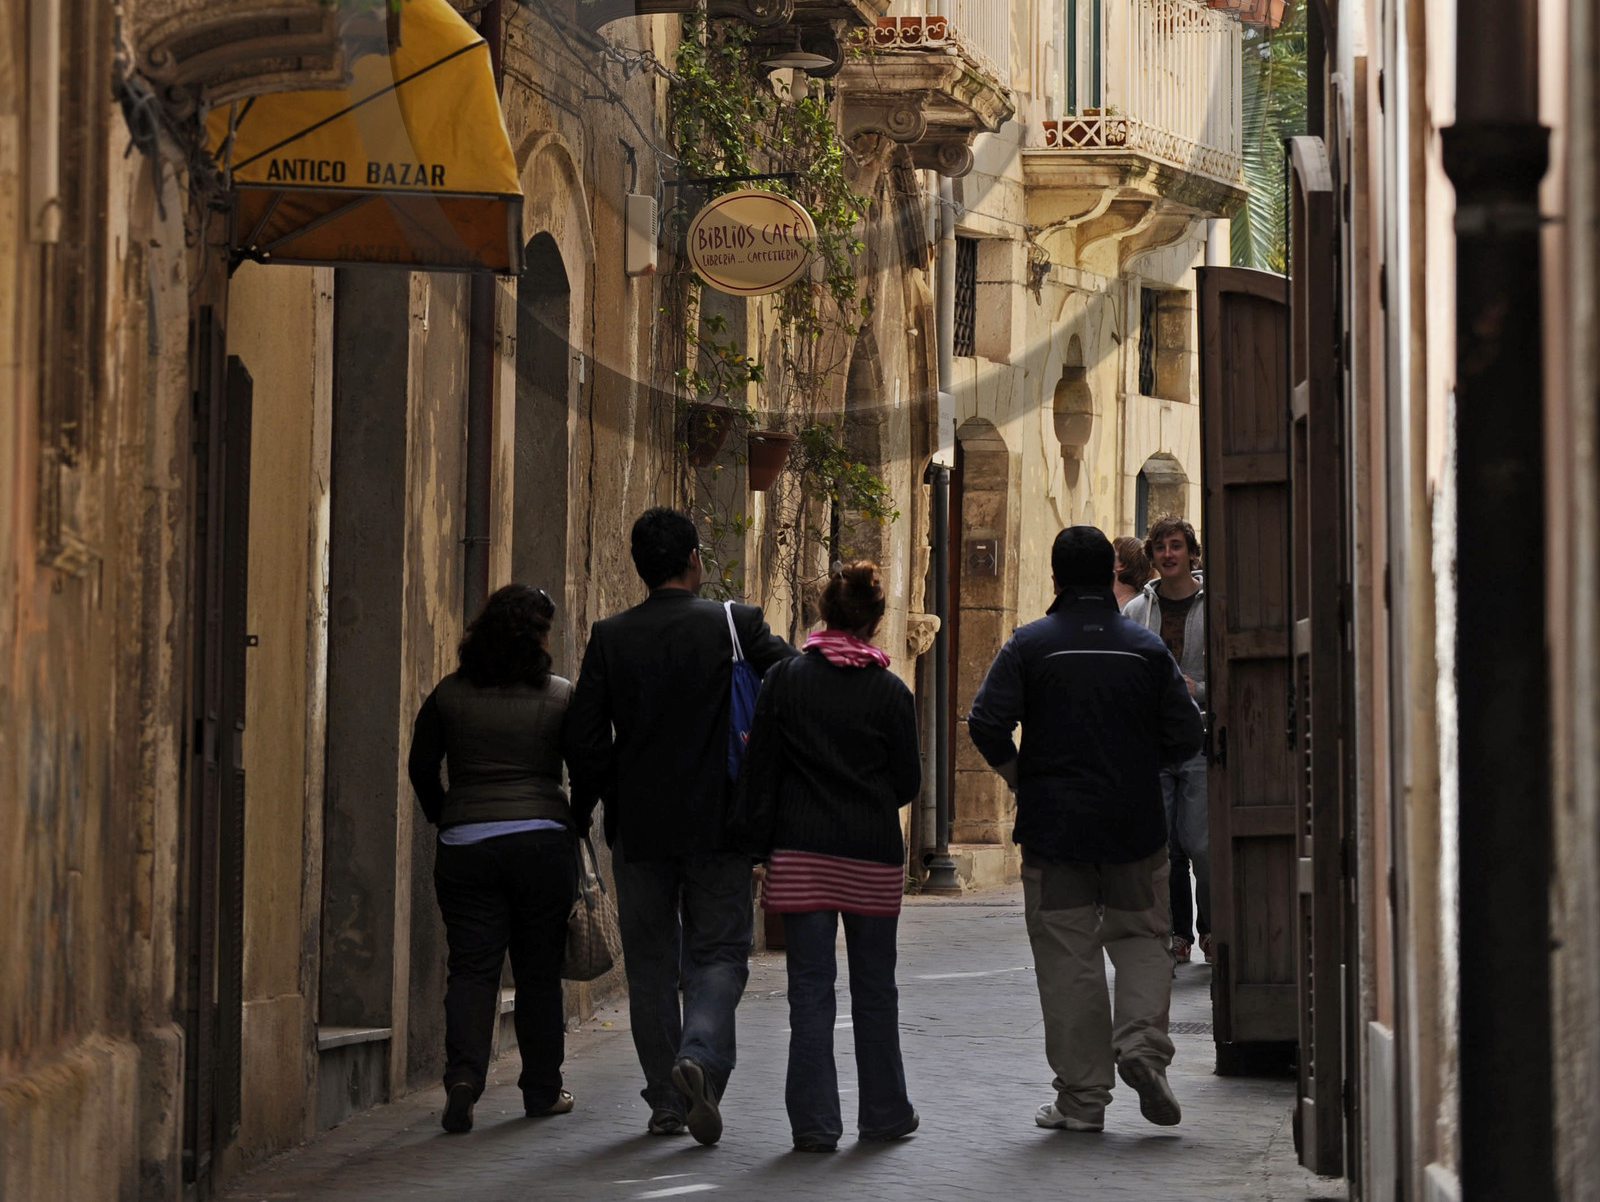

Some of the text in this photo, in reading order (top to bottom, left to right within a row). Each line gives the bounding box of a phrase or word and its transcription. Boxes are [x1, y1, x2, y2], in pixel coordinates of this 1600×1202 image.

[267, 158, 446, 186] ANTICO BAZAR
[747, 248, 799, 263] CAFFETTERIA
